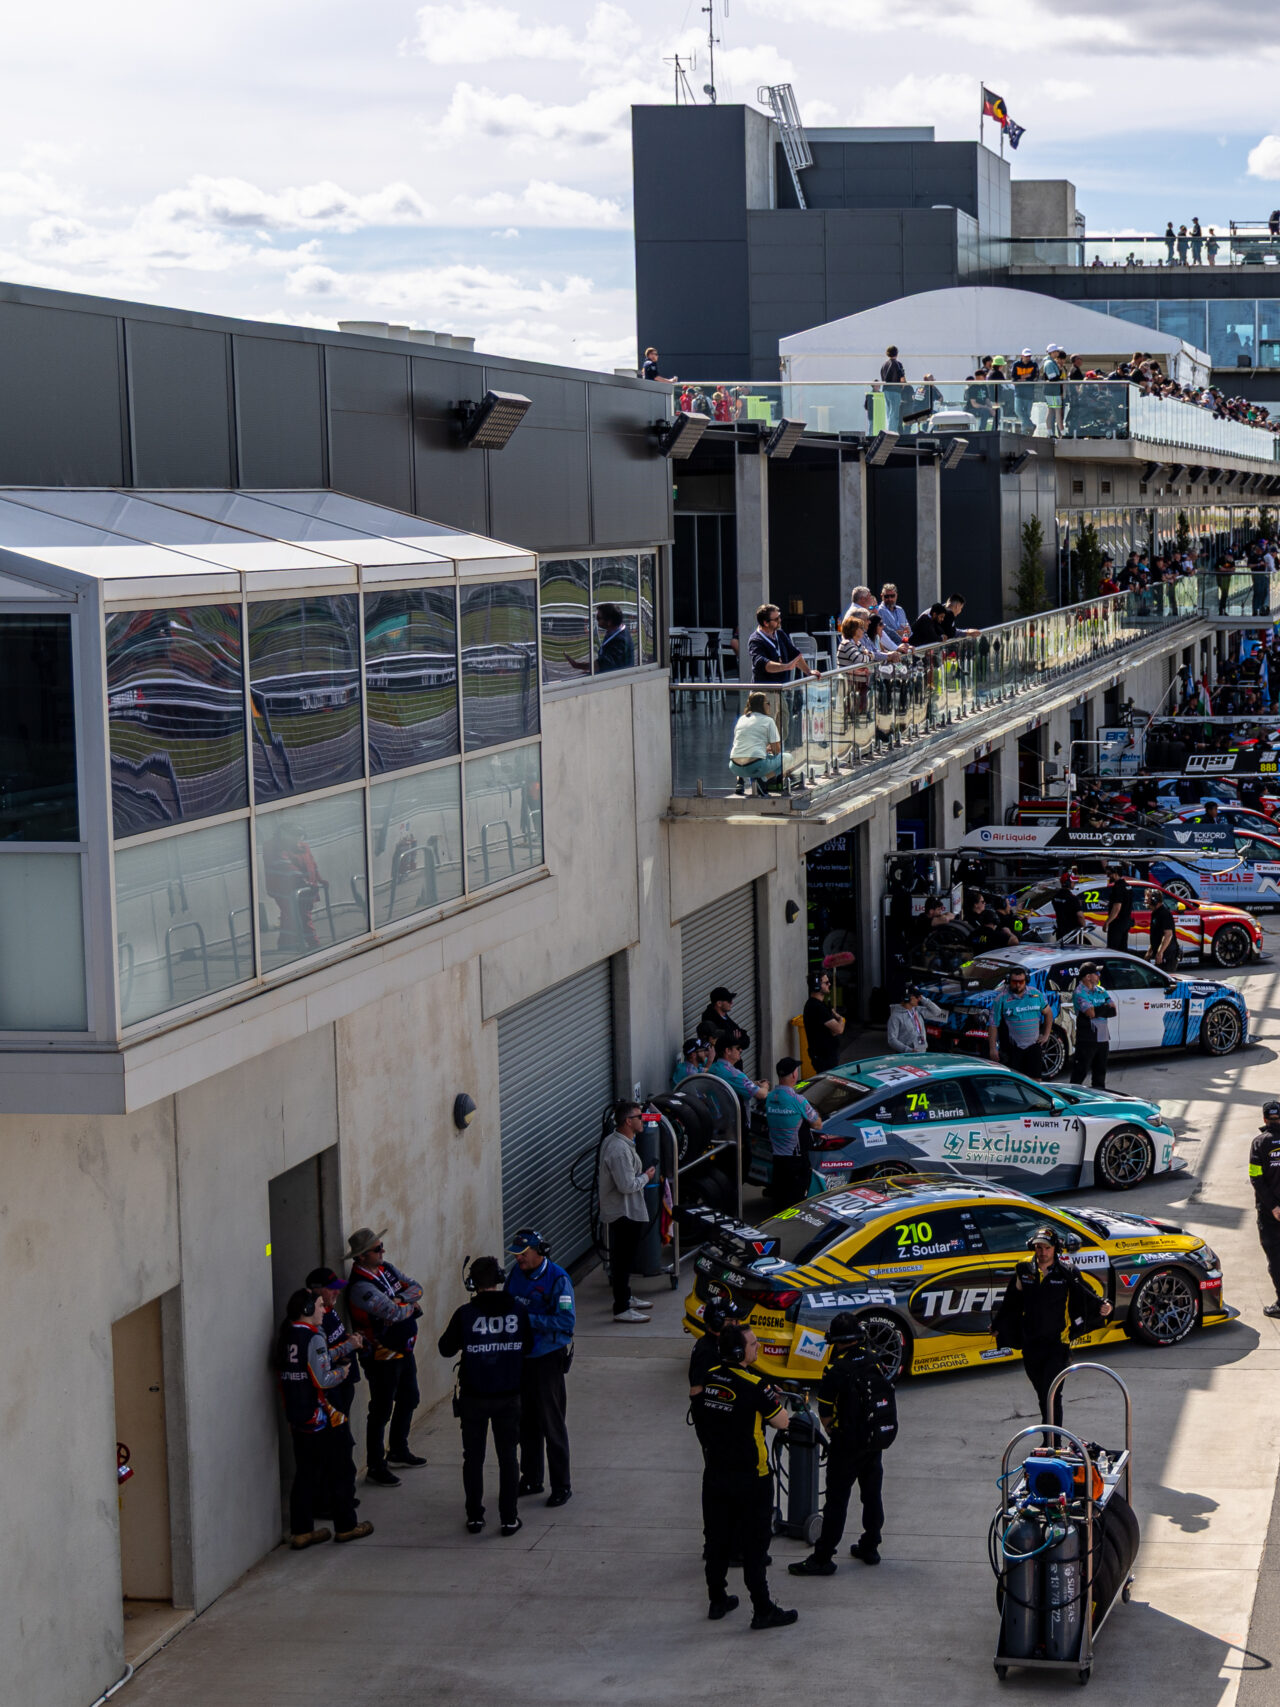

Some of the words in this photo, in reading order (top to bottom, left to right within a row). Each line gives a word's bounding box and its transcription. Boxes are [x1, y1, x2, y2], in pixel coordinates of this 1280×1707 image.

[1260, 763, 1277, 772] 888
[992, 833, 1004, 841] Air
[1005, 833, 1037, 843] Liquide
[1069, 832, 1102, 841] WORLD
[1113, 833, 1136, 841] GYM
[1194, 831, 1227, 840] TICKFORD
[1084, 892, 1099, 903] 22
[1171, 1000, 1182, 1010] 36
[906, 1093, 930, 1111] 74
[928, 1107, 964, 1119] B.Harris
[1063, 1119, 1079, 1132] 74
[968, 1131, 1060, 1155] Exclusive
[966, 1152, 1058, 1165] SWITCHBOARDS
[895, 1221, 933, 1246] 210
[898, 1246, 911, 1258] Z.
[912, 1242, 951, 1257] Soutar
[807, 1289, 897, 1309] LEADER
[472, 1315, 519, 1335] 408
[757, 1315, 785, 1329] COSENG
[870, 1316, 896, 1329] KUMHO
[913, 1358, 969, 1373] UNLOADING
